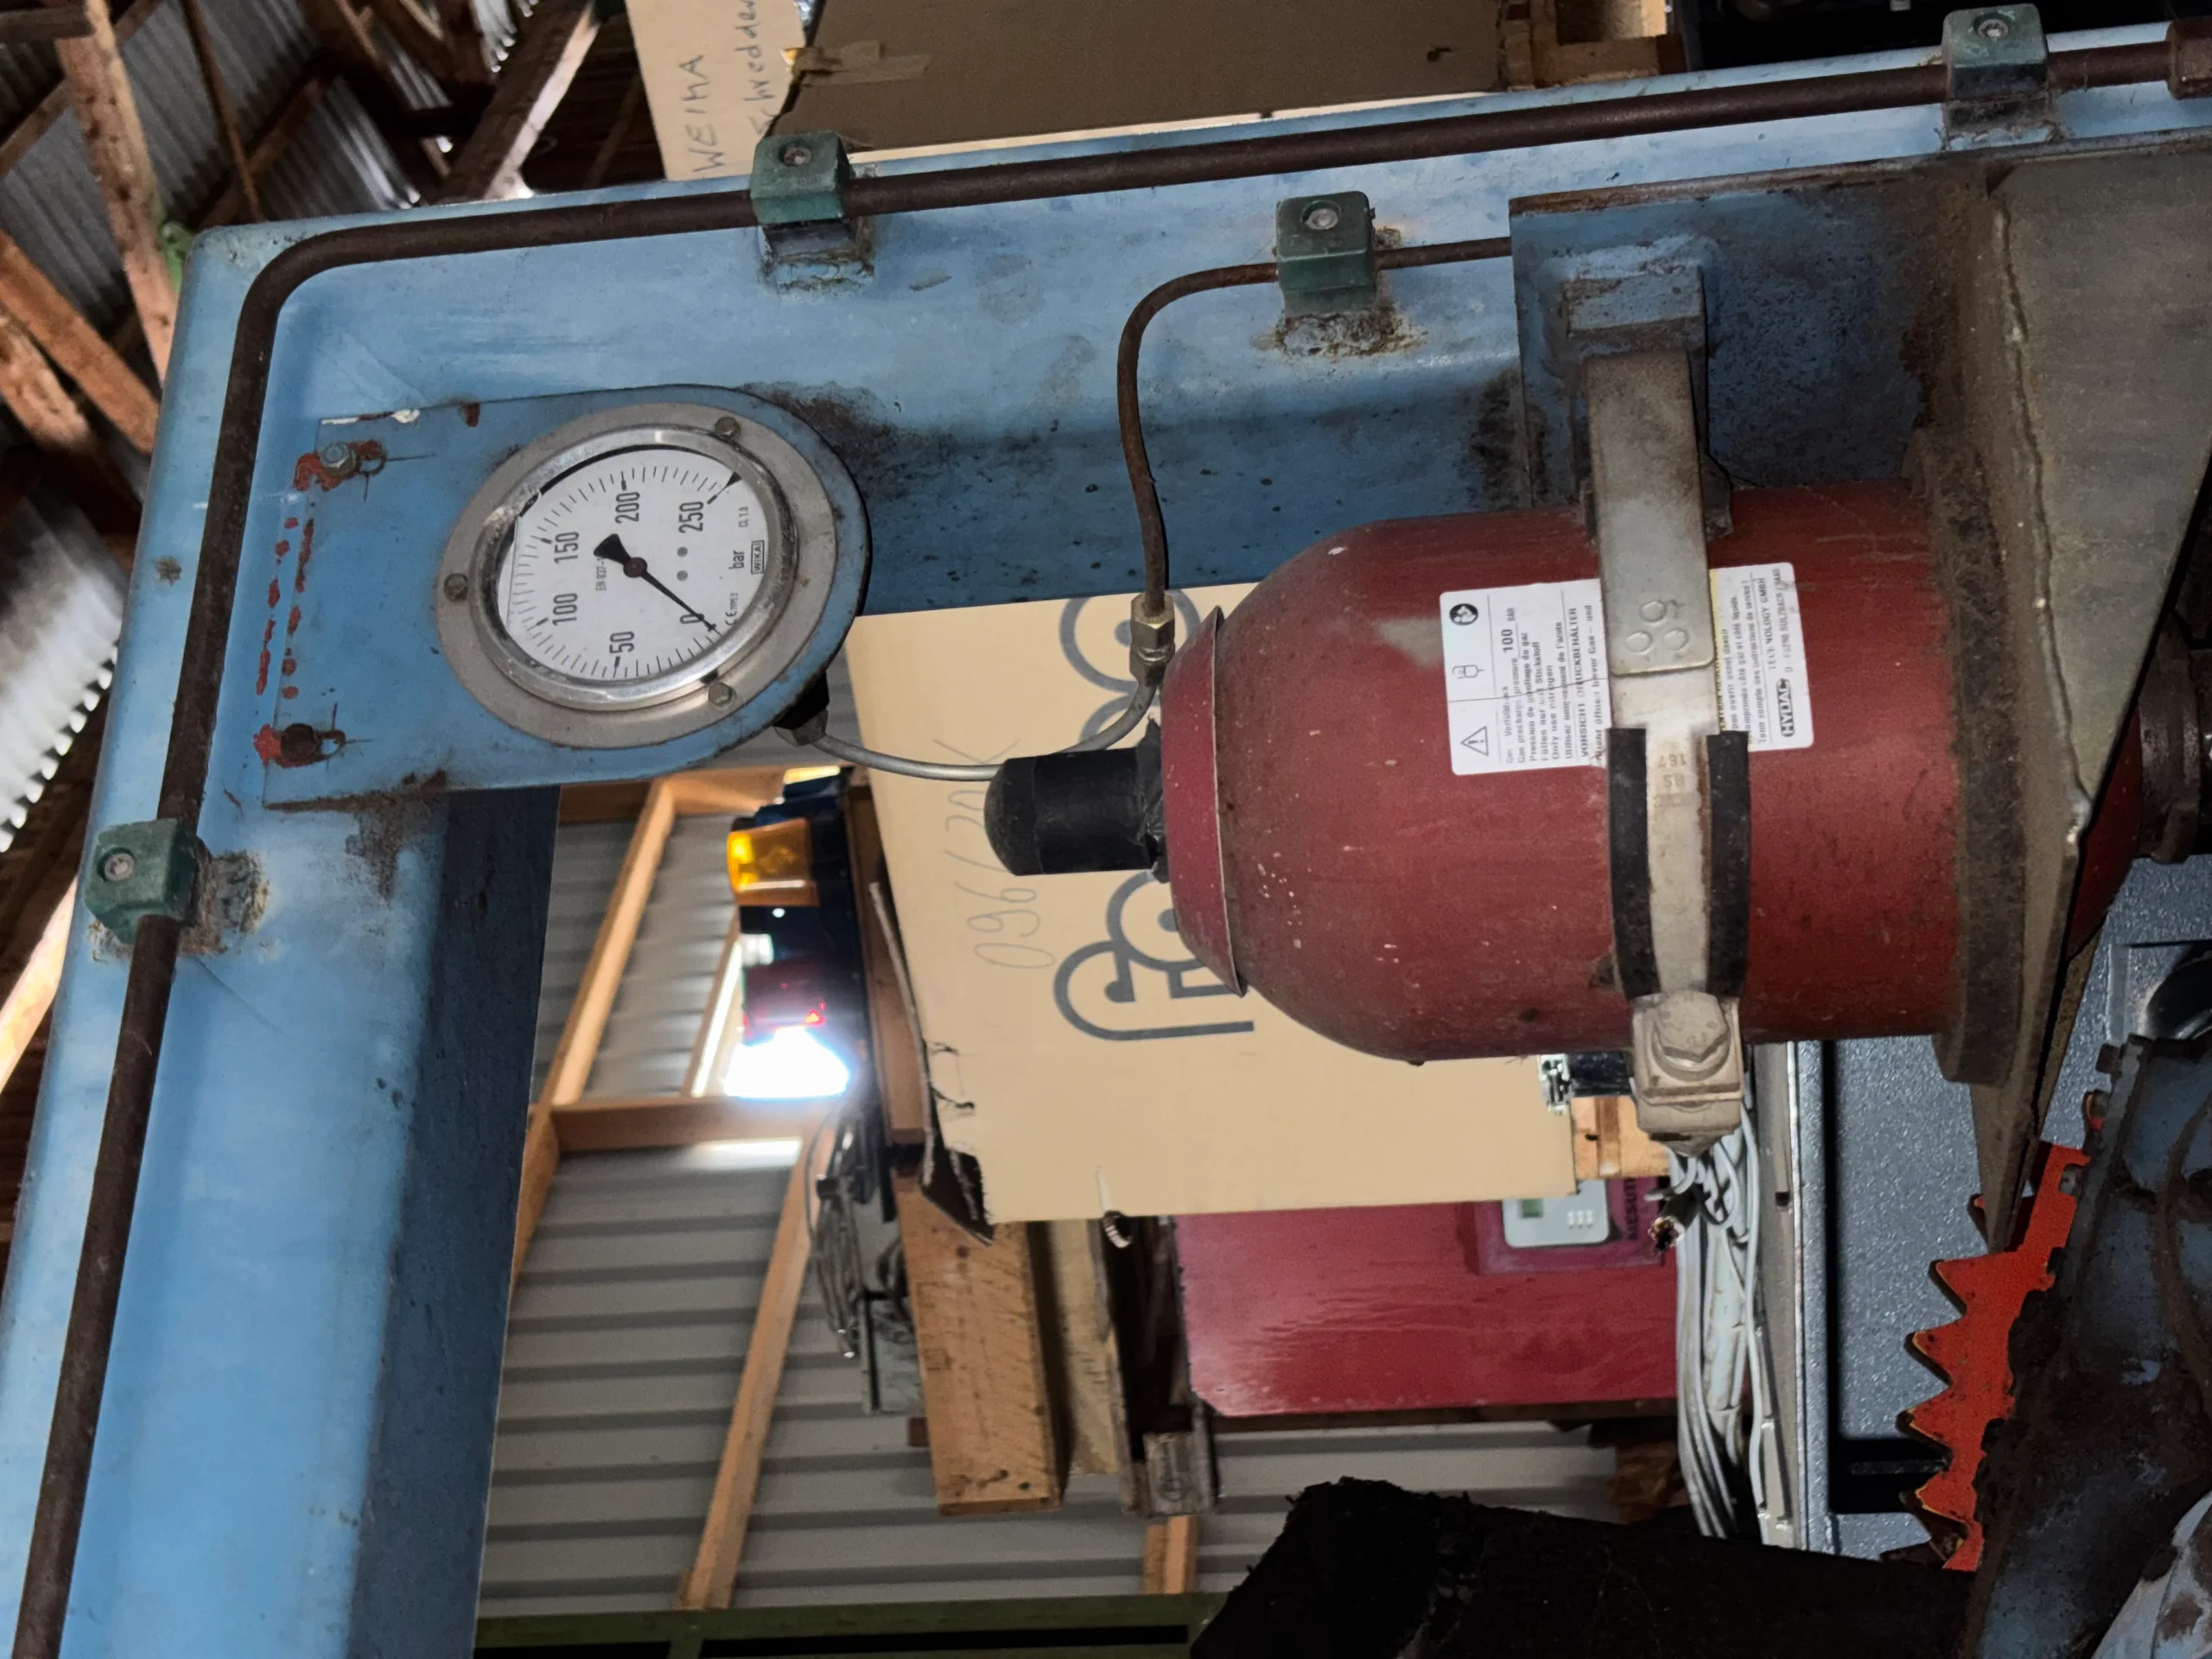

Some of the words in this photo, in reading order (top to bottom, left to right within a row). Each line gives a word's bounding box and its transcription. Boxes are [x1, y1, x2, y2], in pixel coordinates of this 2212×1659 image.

[677, 55, 726, 173] WEIMA
[615, 493, 640, 524] 200
[678, 501, 703, 533] 250
[554, 531, 579, 563] 150
[728, 550, 744, 569] bar
[552, 593, 578, 626] 100
[680, 613, 704, 625] 0
[1583, 604, 1593, 621] und
[609, 632, 634, 653] 50
[1501, 629, 1514, 653] 100
[1520, 632, 1530, 646] gaz
[1586, 635, 1597, 654] Gas
[1521, 649, 1529, 660] du
[1777, 680, 1795, 736] HYDAC
[1549, 712, 1559, 732] use
[1576, 702, 1589, 758] VORSICHT
[1516, 747, 1525, 763] Gas
[1550, 735, 1560, 760] Only
[1624, 1177, 1638, 1241] MESUT
